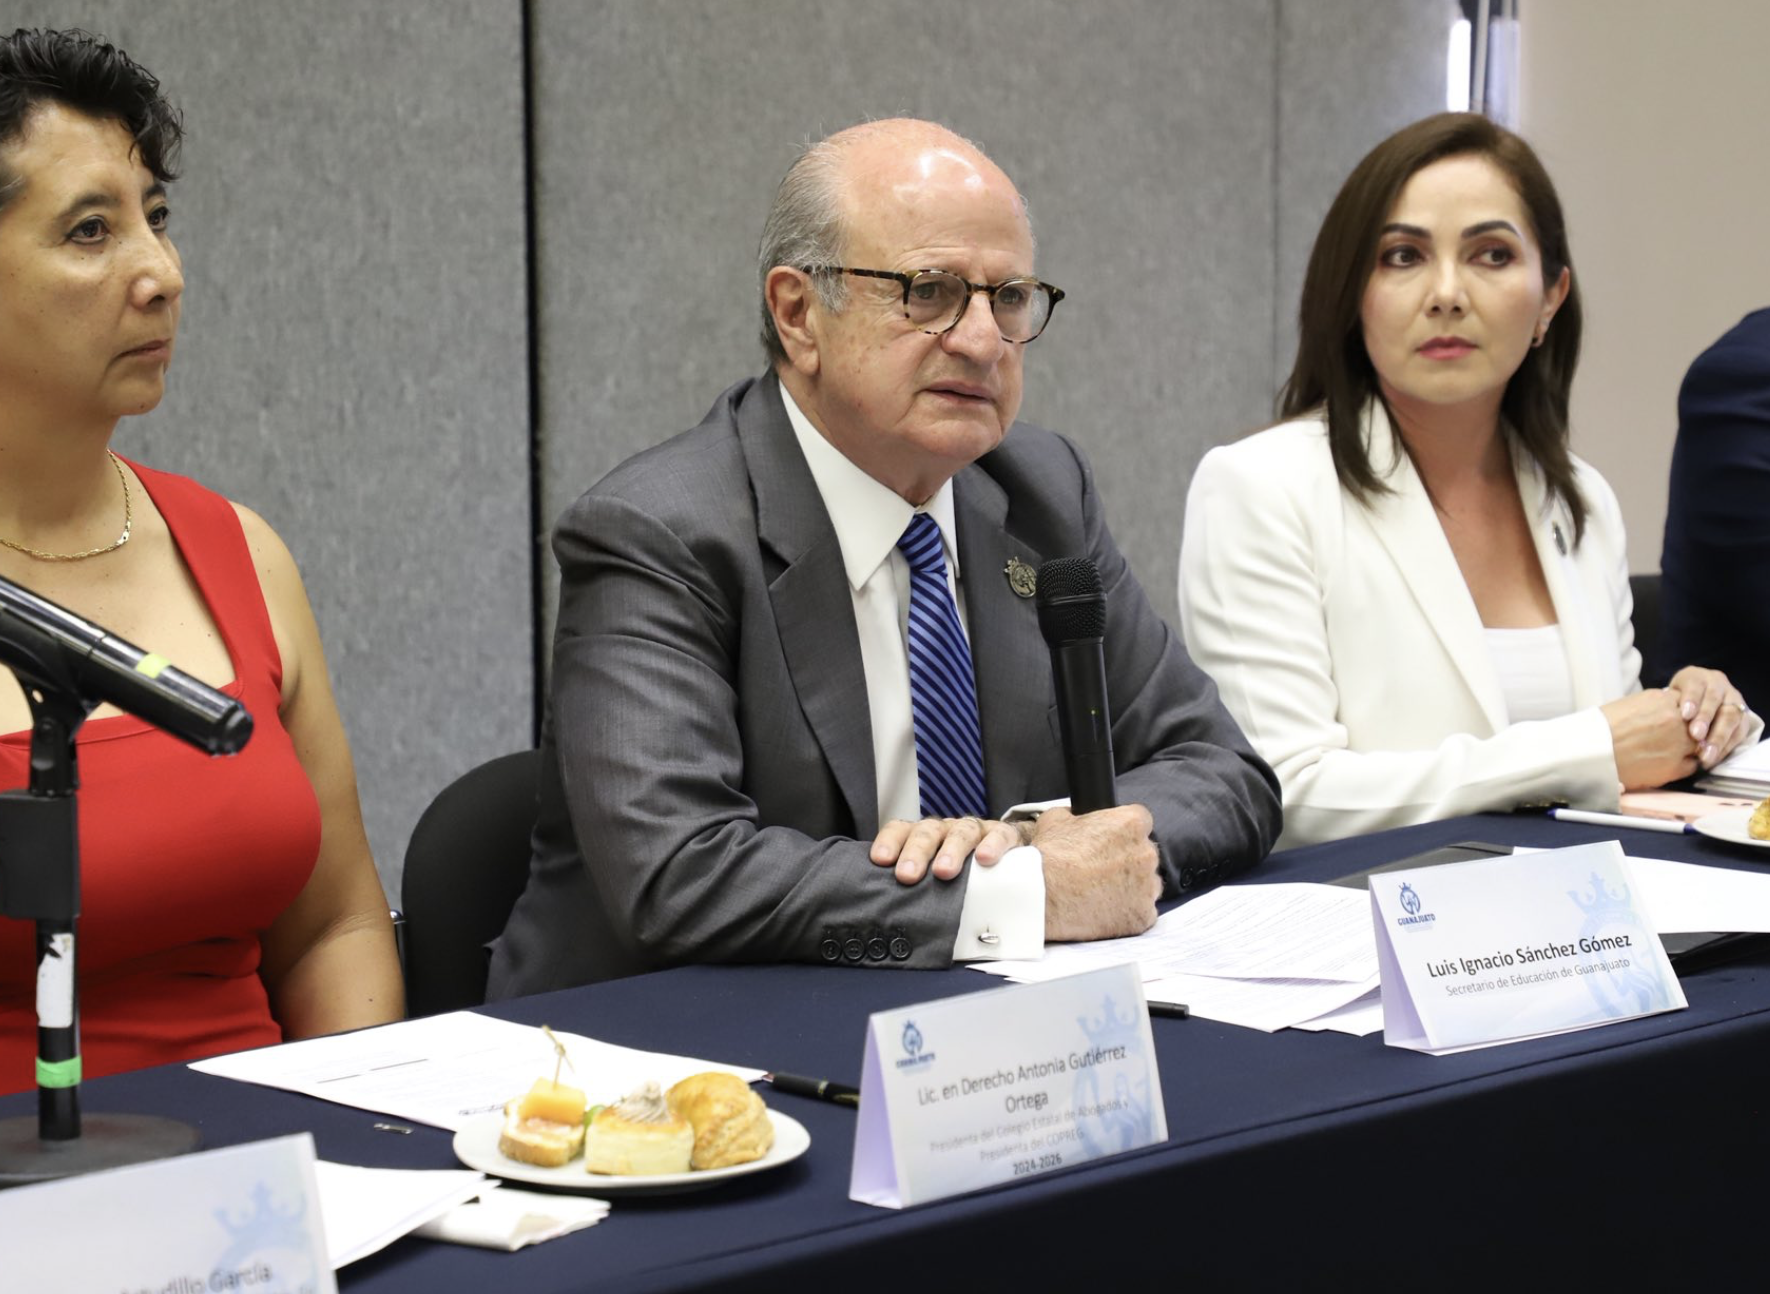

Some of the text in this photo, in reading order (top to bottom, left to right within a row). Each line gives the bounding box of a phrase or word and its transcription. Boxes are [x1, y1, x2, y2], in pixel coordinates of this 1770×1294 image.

[1427, 935, 1632, 978] Luis Ignacio Sánchez Gómez
[1445, 957, 1631, 997] Secretario de Educación de Guanajuato
[917, 1045, 1127, 1106] Lic. en Derecho Antonia Gutiérrez
[1005, 1091, 1049, 1114] Ortega
[930, 1132, 978, 1152] Presidenta
[980, 1127, 994, 1140] del
[996, 1119, 1030, 1137] Colegio
[1064, 1109, 1076, 1121] de
[1078, 1100, 1122, 1118] Abogados
[980, 1142, 1028, 1162] Presidenta
[1030, 1137, 1044, 1149] del
[1013, 1152, 1063, 1176] 2024-2026
[208, 1262, 272, 1293] García
